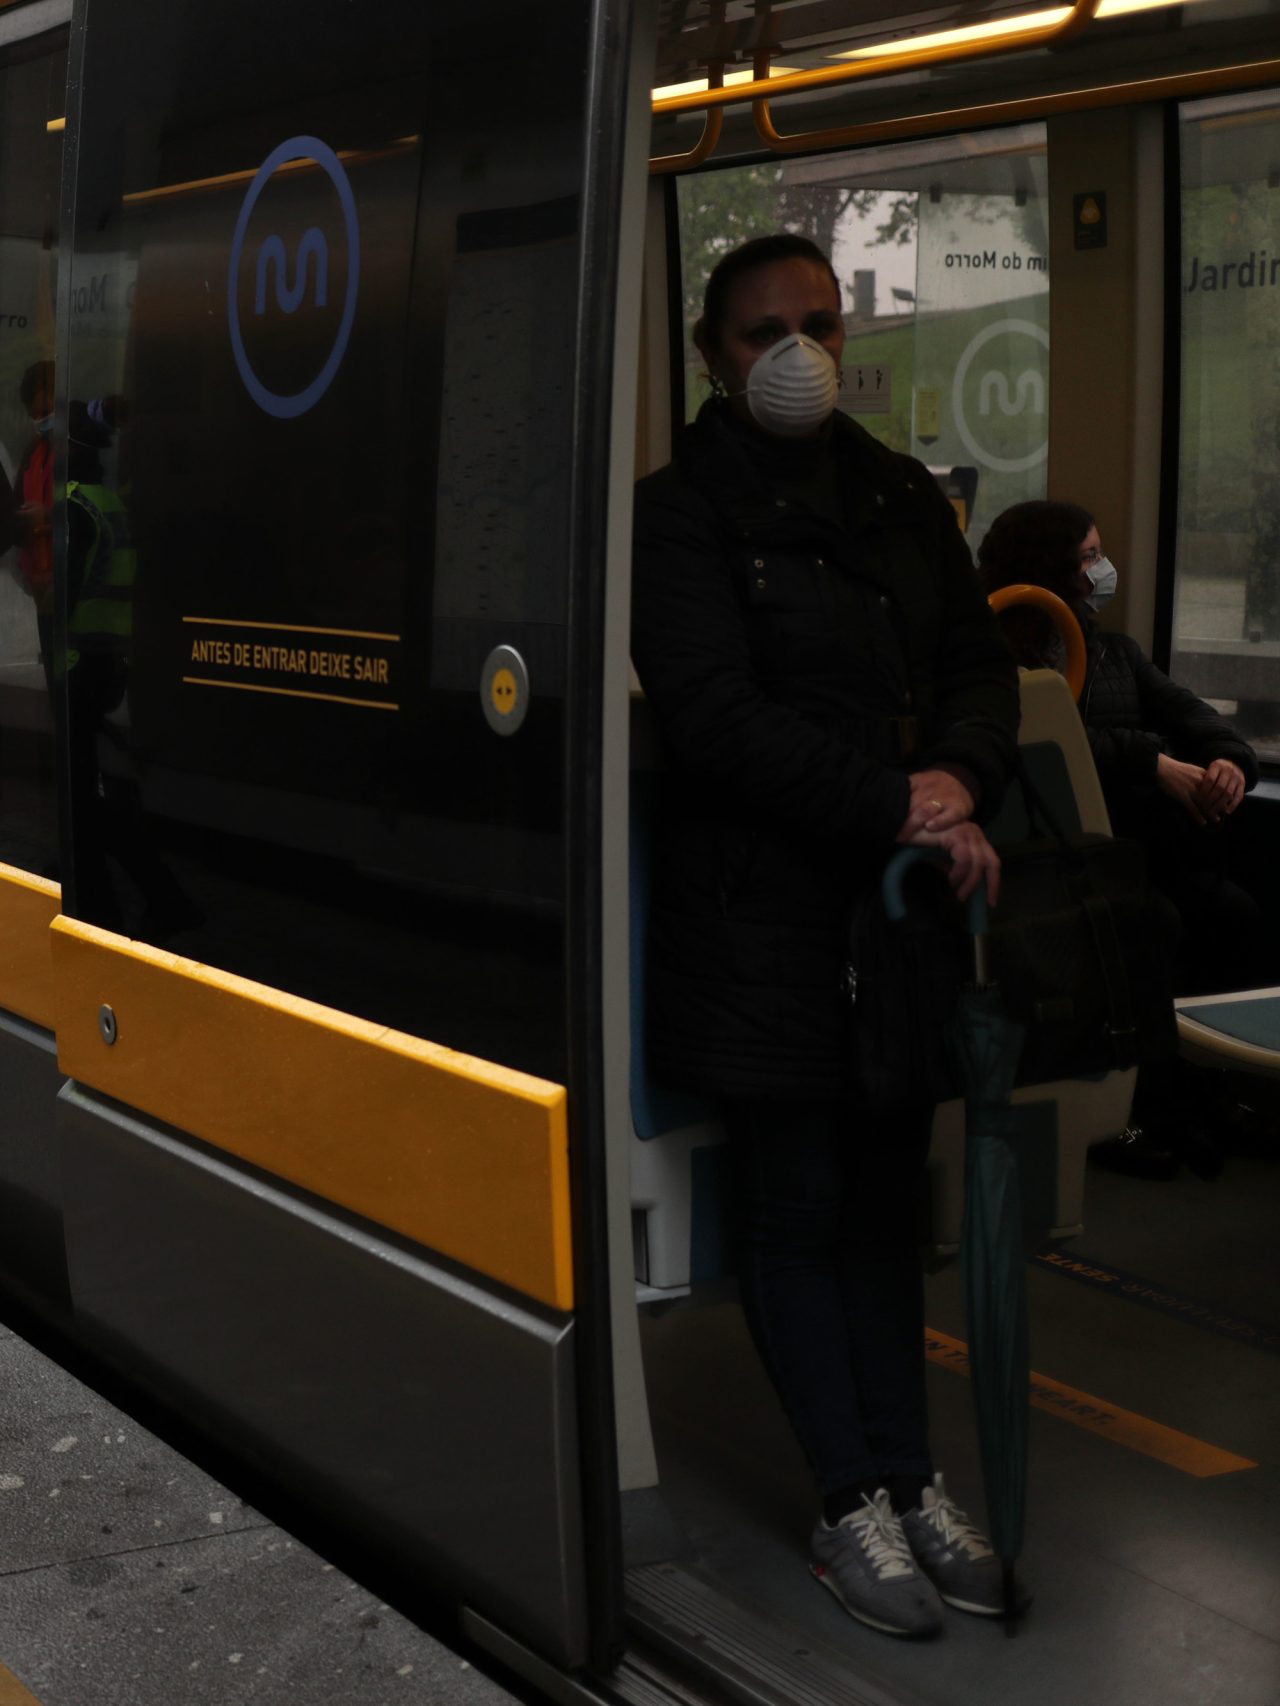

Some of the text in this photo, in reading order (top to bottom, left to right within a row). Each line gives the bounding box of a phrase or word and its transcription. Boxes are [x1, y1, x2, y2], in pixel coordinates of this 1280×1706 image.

[191, 639, 390, 685] ANTES DE ENTRAR DEIXE SAIR
